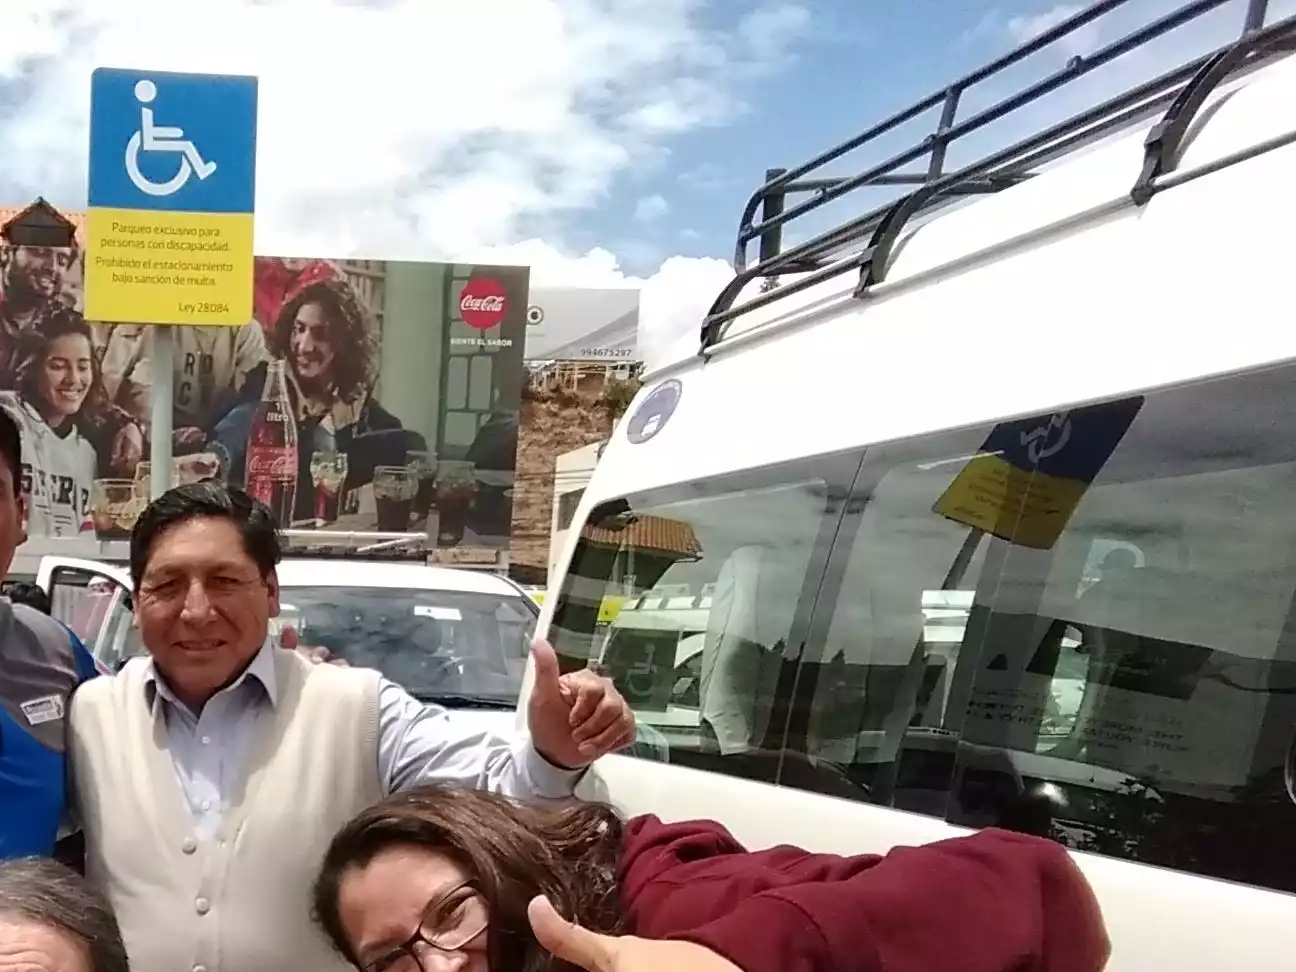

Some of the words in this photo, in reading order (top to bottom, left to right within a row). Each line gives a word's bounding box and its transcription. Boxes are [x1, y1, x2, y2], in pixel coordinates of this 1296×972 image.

[112, 222, 152, 236] Parqueo
[153, 226, 198, 237] exclusivo
[199, 228, 221, 238] para
[100, 237, 145, 250] personas
[147, 239, 165, 249] con
[95, 256, 142, 269] Prohibido
[142, 258, 152, 269] el
[152, 259, 234, 272] estacionamiento
[112, 271, 134, 285] bajo
[172, 274, 186, 286] de
[178, 302, 197, 315] Ley
[197, 303, 230, 313] 28084
